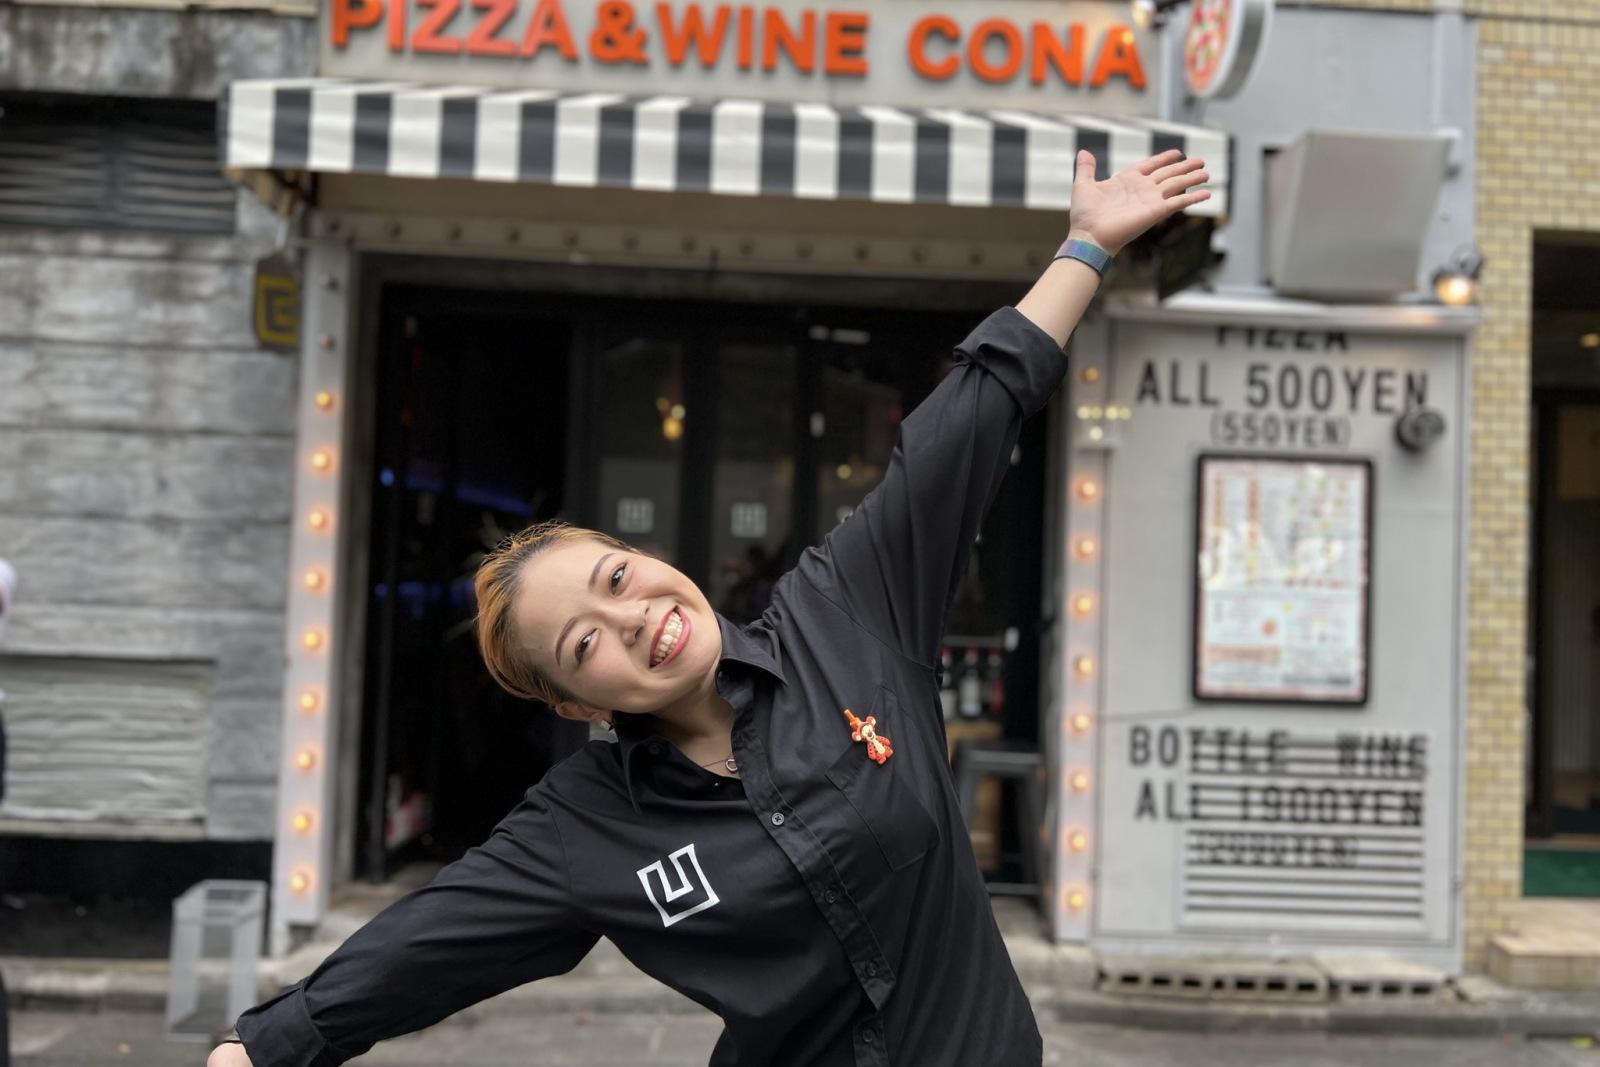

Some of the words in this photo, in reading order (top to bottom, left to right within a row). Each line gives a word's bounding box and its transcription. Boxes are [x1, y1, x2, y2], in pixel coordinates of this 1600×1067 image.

[907, 14, 1147, 88] CONA
[1136, 359, 1220, 406] ALL
[1245, 362, 1428, 415] 500YEN
[1211, 411, 1351, 449] (550YEN)
[1129, 725, 1289, 773] BOTTLE
[1337, 731, 1428, 778] WINE
